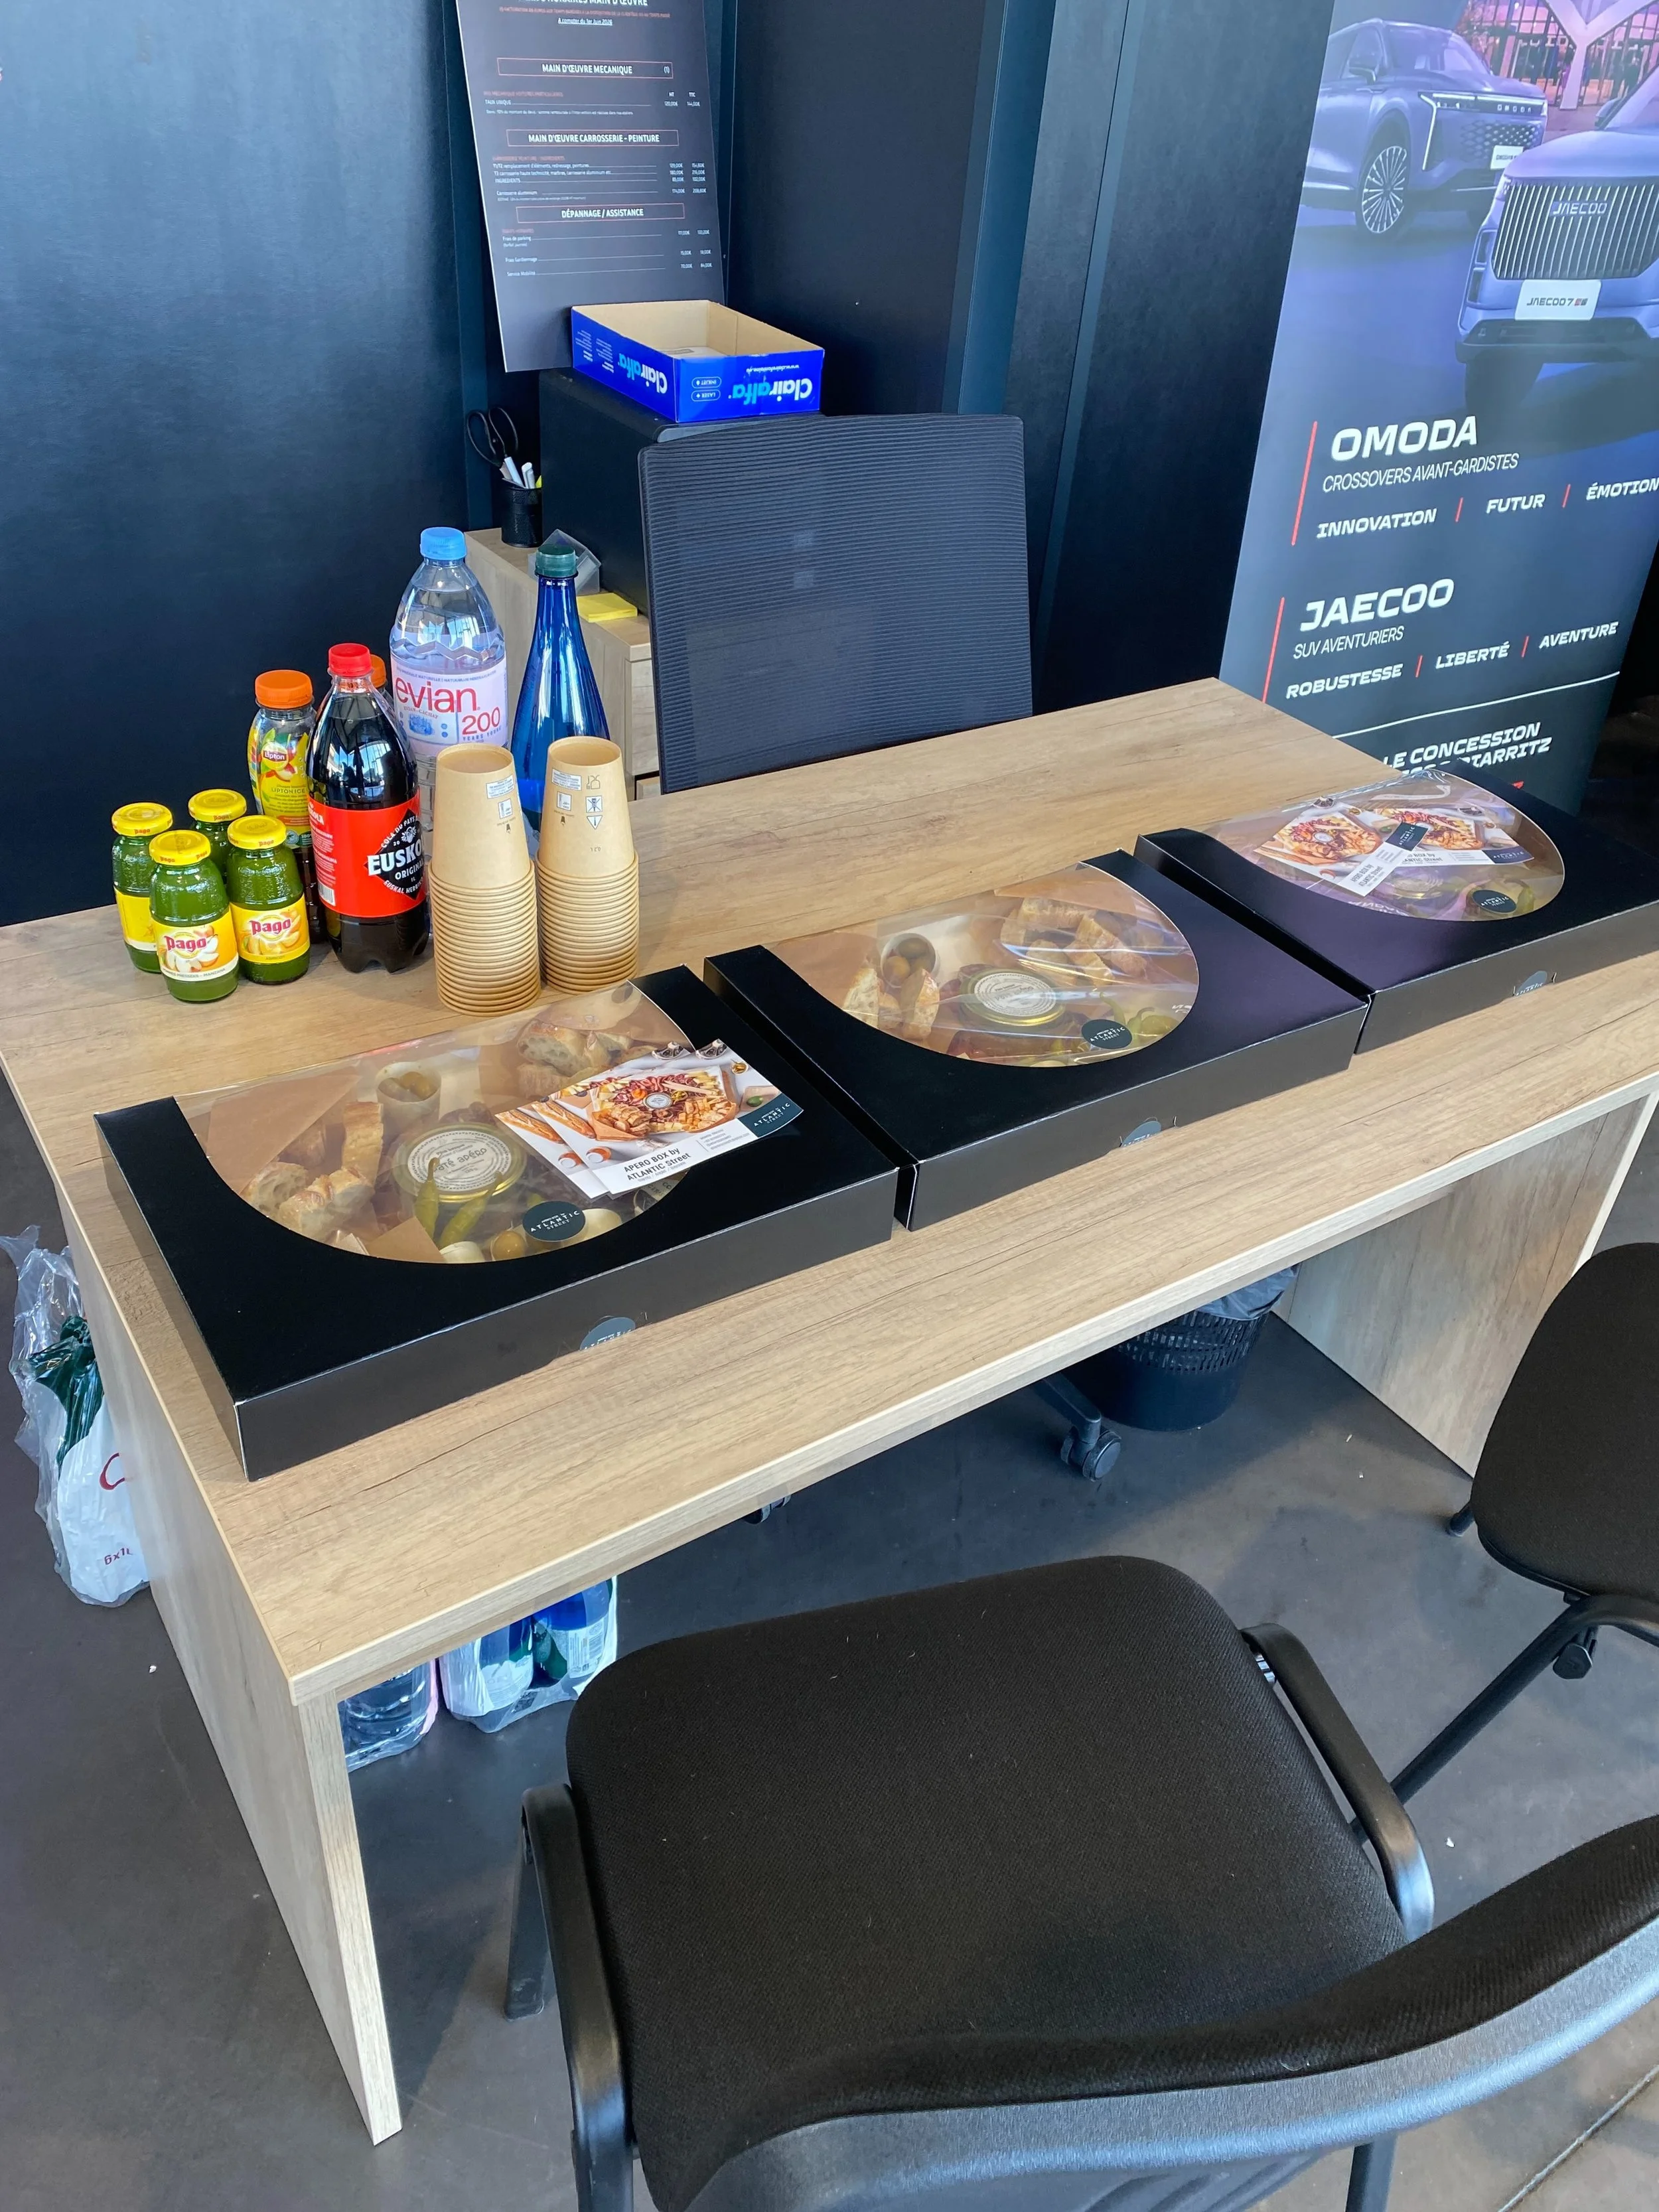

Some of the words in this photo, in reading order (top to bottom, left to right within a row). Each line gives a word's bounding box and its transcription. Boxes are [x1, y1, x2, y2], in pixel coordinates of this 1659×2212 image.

[542, 64, 561, 72] MAIN
[562, 64, 593, 73] D'ŒUVRE
[594, 65, 632, 76] MECANIQUE
[548, 134, 579, 143] D'ŒUVRE
[579, 134, 623, 143] CARROSSERIE
[628, 134, 660, 143] PEINTURE
[561, 208, 601, 218] DÉPANNAGE
[606, 208, 644, 217] ASSISTANCE
[1553, 202, 1607, 215] JAECOO
[618, 352, 668, 394] Clairalfa
[732, 378, 813, 406] Clairalfa
[1331, 415, 1478, 461] OMODA
[1323, 468, 1411, 493] CROSSOVERS
[1412, 453, 1520, 482] AVANT-GARDISTES
[1317, 508, 1437, 538] INNOVATION
[1486, 494, 1546, 514] FUTUR
[1300, 579, 1455, 632] JAECOO
[1293, 642, 1321, 660] SUV
[1321, 626, 1405, 654] AVENTURIERS
[1286, 664, 1403, 699] ROBUSTESSE
[1435, 642, 1510, 670] LIBERTÉ
[1539, 622, 1619, 649] AVENTURE
[395, 677, 477, 713] evian
[461, 707, 500, 735] 200
[264, 751, 285, 761] Lipton
[1409, 721, 1541, 763] CONCESSION
[381, 832, 396, 848] COLA
[396, 824, 403, 834] DU
[403, 816, 415, 826] PAYS
[367, 839, 423, 876] EUSKO
[384, 880, 404, 893] EUSKAL
[249, 919, 291, 936] pago
[164, 935, 206, 953] pago
[1090, 1027, 1125, 1042] ATLANTIC
[754, 1102, 790, 1127] ATLANTIC
[624, 1159, 652, 1173] APERO
[652, 1151, 669, 1165] BOX
[670, 1147, 680, 1159] by
[626, 1163, 666, 1181] ATLANTIC
[666, 1152, 691, 1167] Street
[531, 1211, 580, 1232] ATLANTIC
[546, 1219, 569, 1230] STREET
